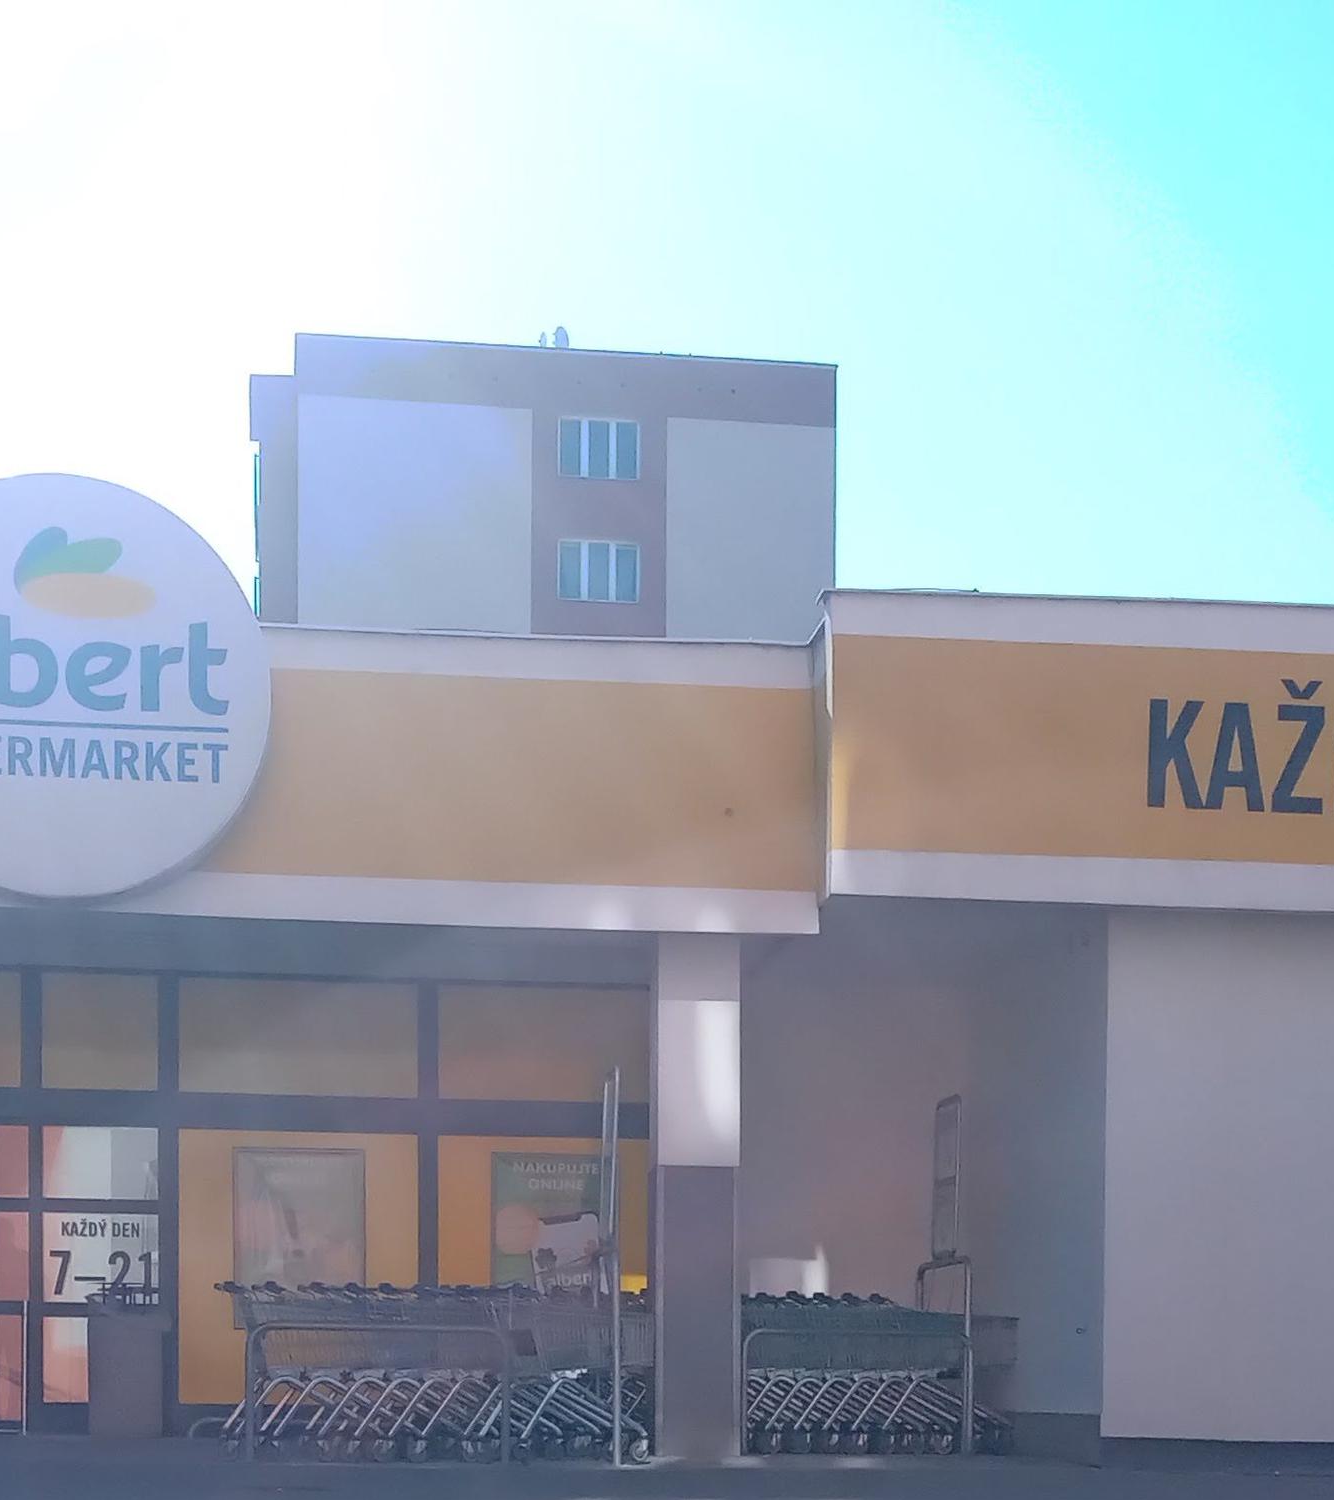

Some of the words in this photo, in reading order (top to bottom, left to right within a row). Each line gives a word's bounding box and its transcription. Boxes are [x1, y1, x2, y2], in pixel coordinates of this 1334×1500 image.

[513, 1161, 599, 1175] NAKUPUJTE
[528, 1178, 586, 1192] ONLINE
[61, 1217, 107, 1237] KAŽDÝ
[112, 1222, 140, 1238] DEN
